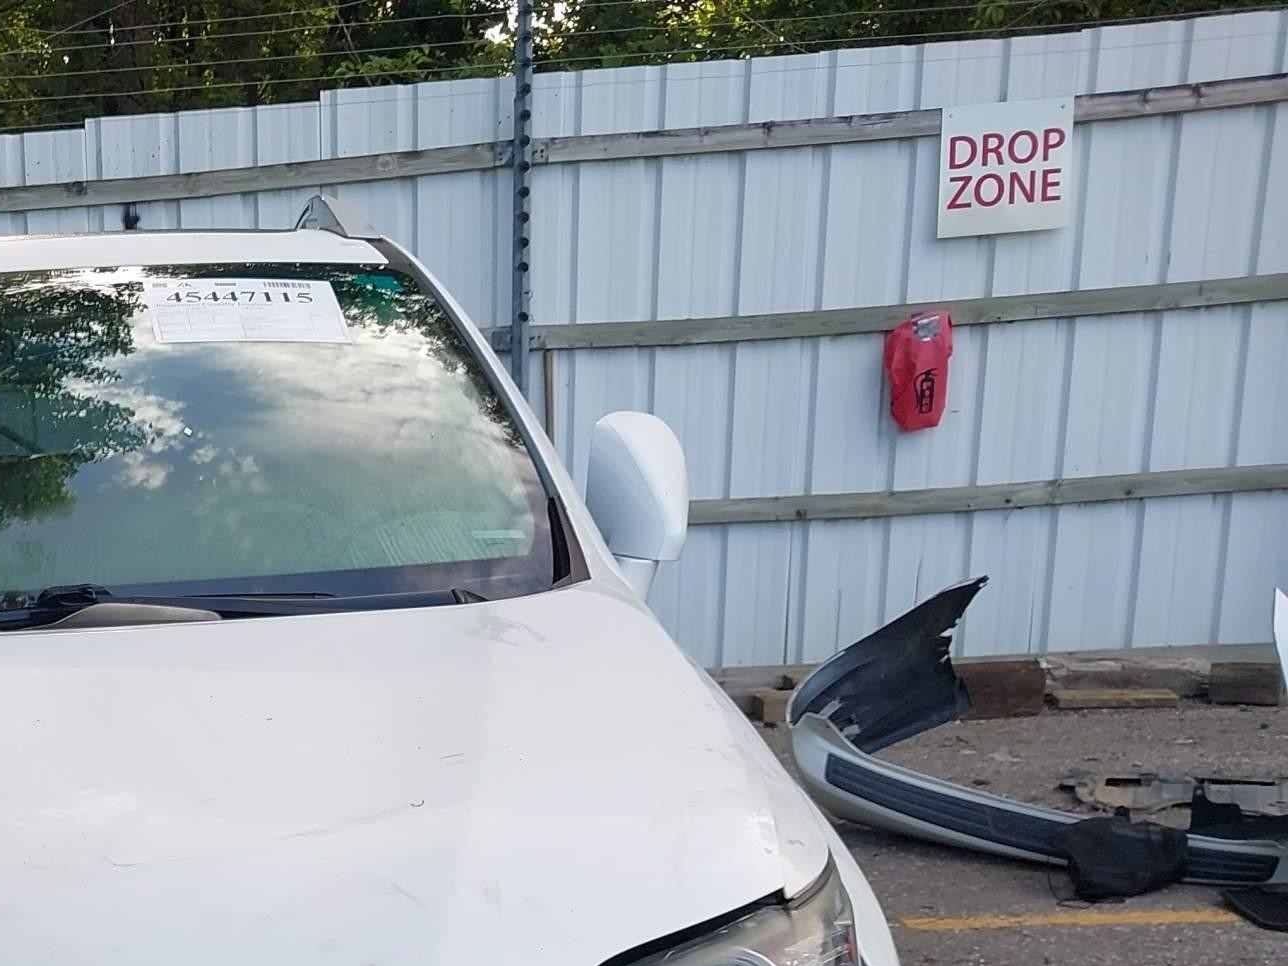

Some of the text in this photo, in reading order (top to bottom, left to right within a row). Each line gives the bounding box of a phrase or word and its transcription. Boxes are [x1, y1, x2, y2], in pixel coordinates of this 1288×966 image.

[948, 127, 1066, 170] DROP
[946, 168, 1062, 210] ZONE
[166, 290, 314, 304] 45447115
